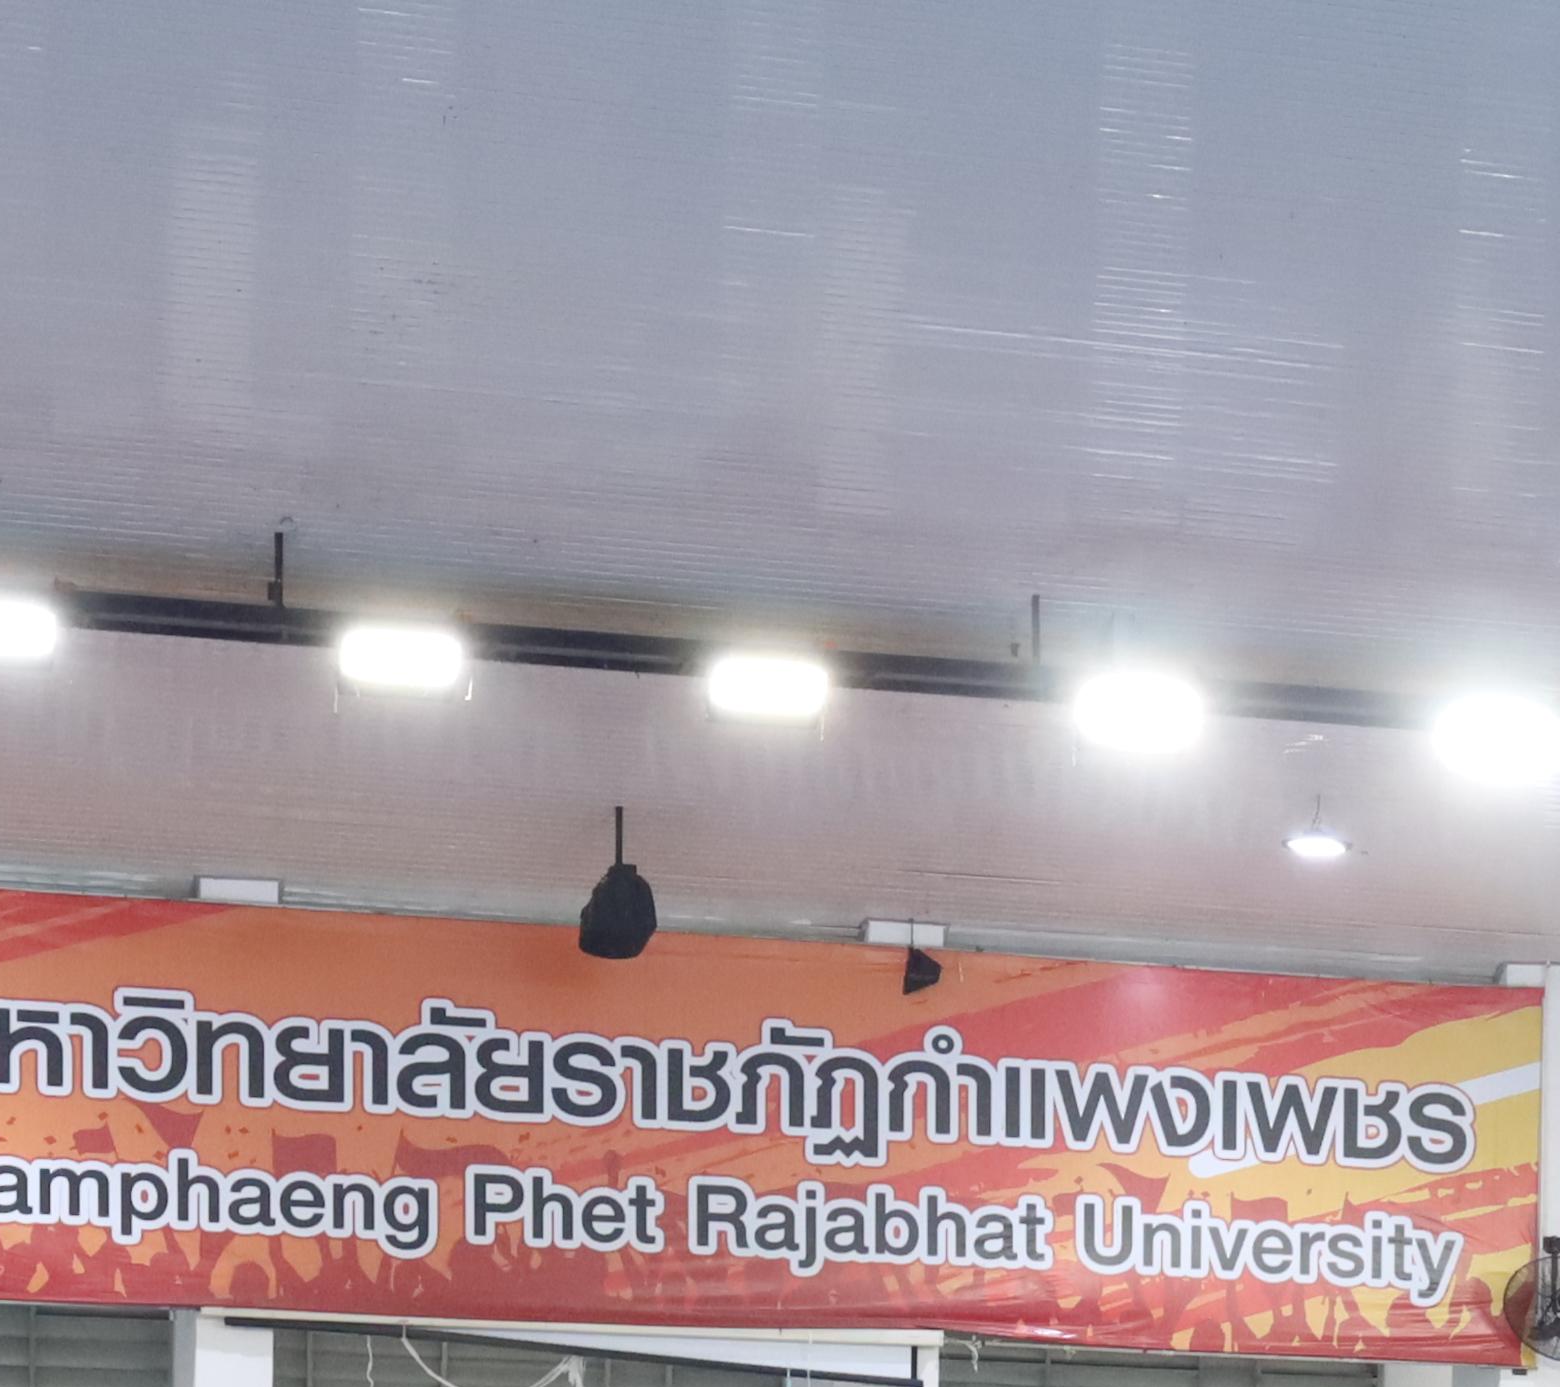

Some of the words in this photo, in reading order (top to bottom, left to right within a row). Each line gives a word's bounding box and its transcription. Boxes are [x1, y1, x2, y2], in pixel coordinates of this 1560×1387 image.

[473, 1174, 658, 1246] Phet
[696, 1185, 1045, 1270] Rajabhat
[1084, 1203, 1457, 1300] University
